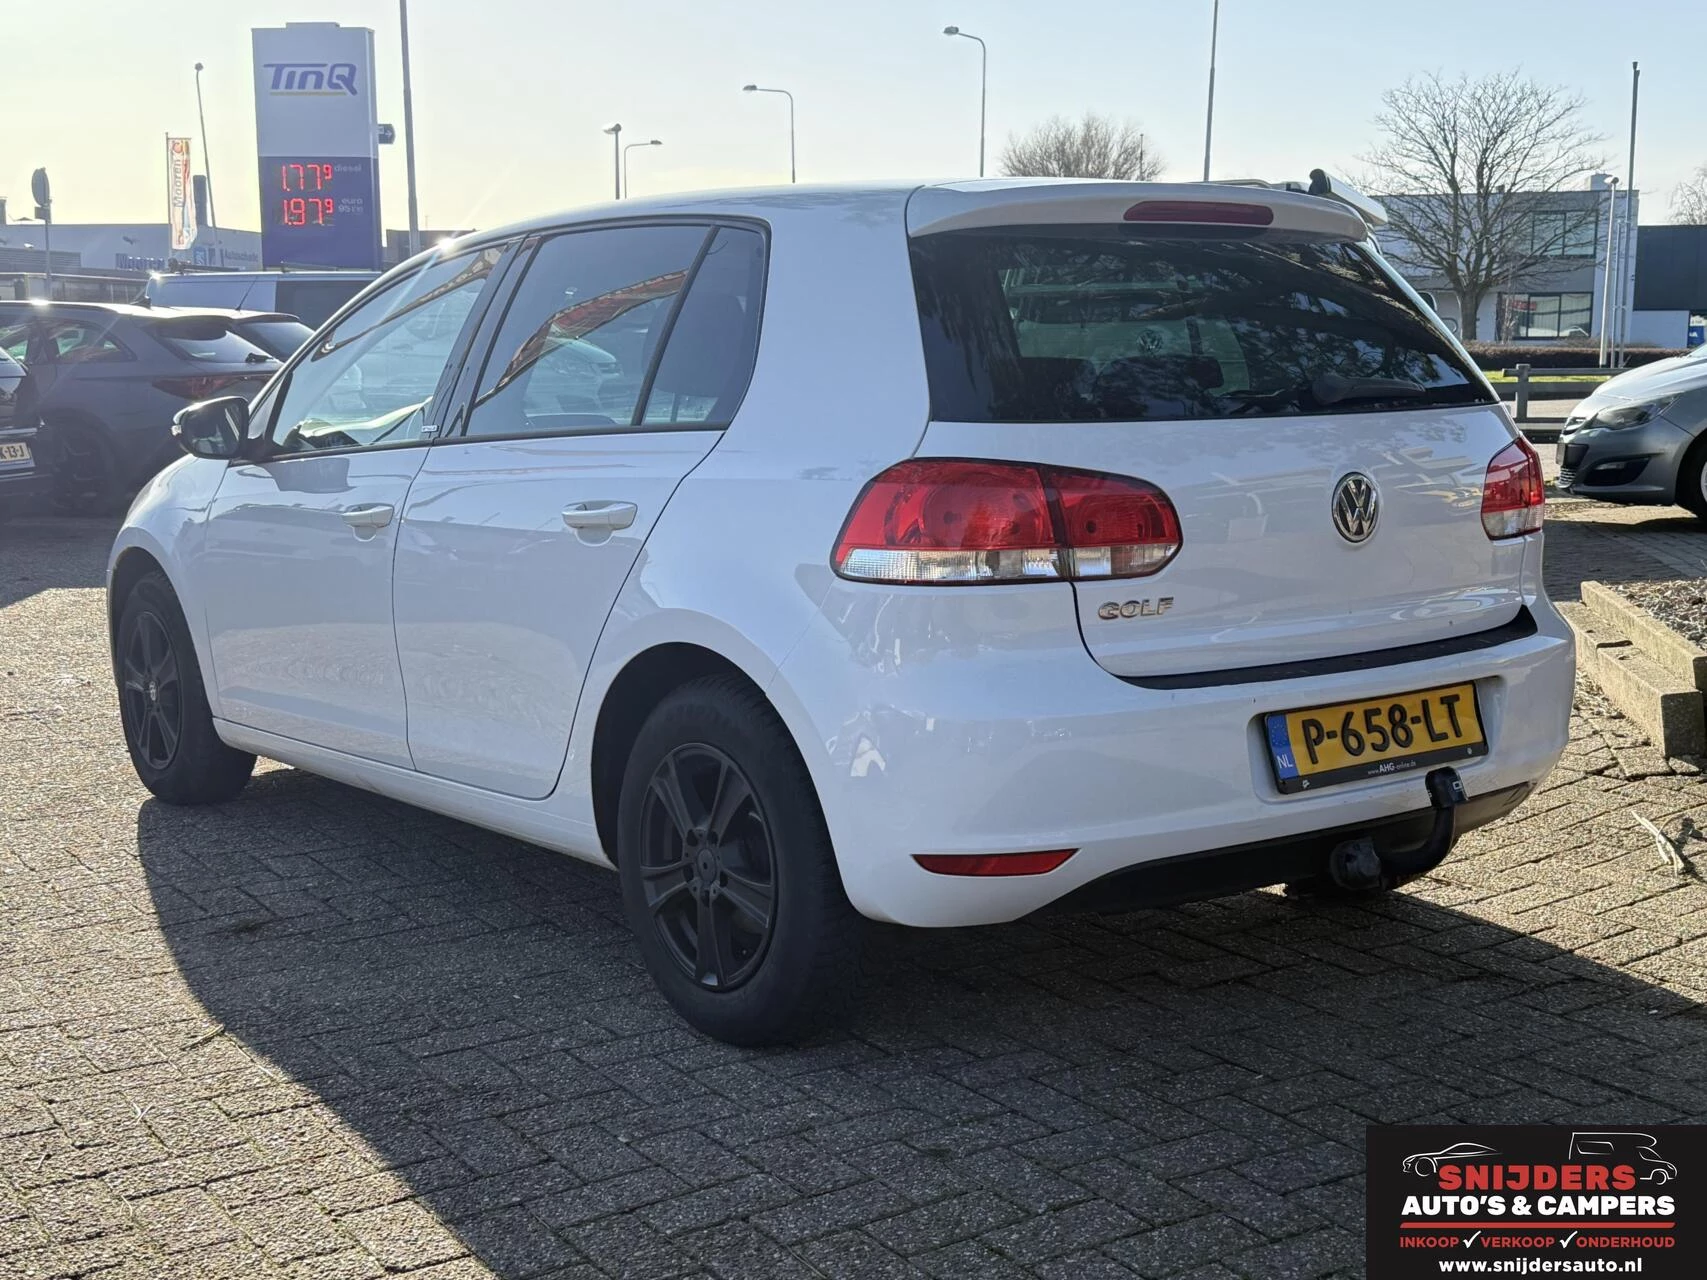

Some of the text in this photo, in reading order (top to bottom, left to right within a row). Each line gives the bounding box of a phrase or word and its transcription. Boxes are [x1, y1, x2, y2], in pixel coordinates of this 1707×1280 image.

[1098, 597, 1174, 620] GOLF
[1302, 694, 1464, 765] P-658-LT
[1277, 754, 1294, 769] NL
